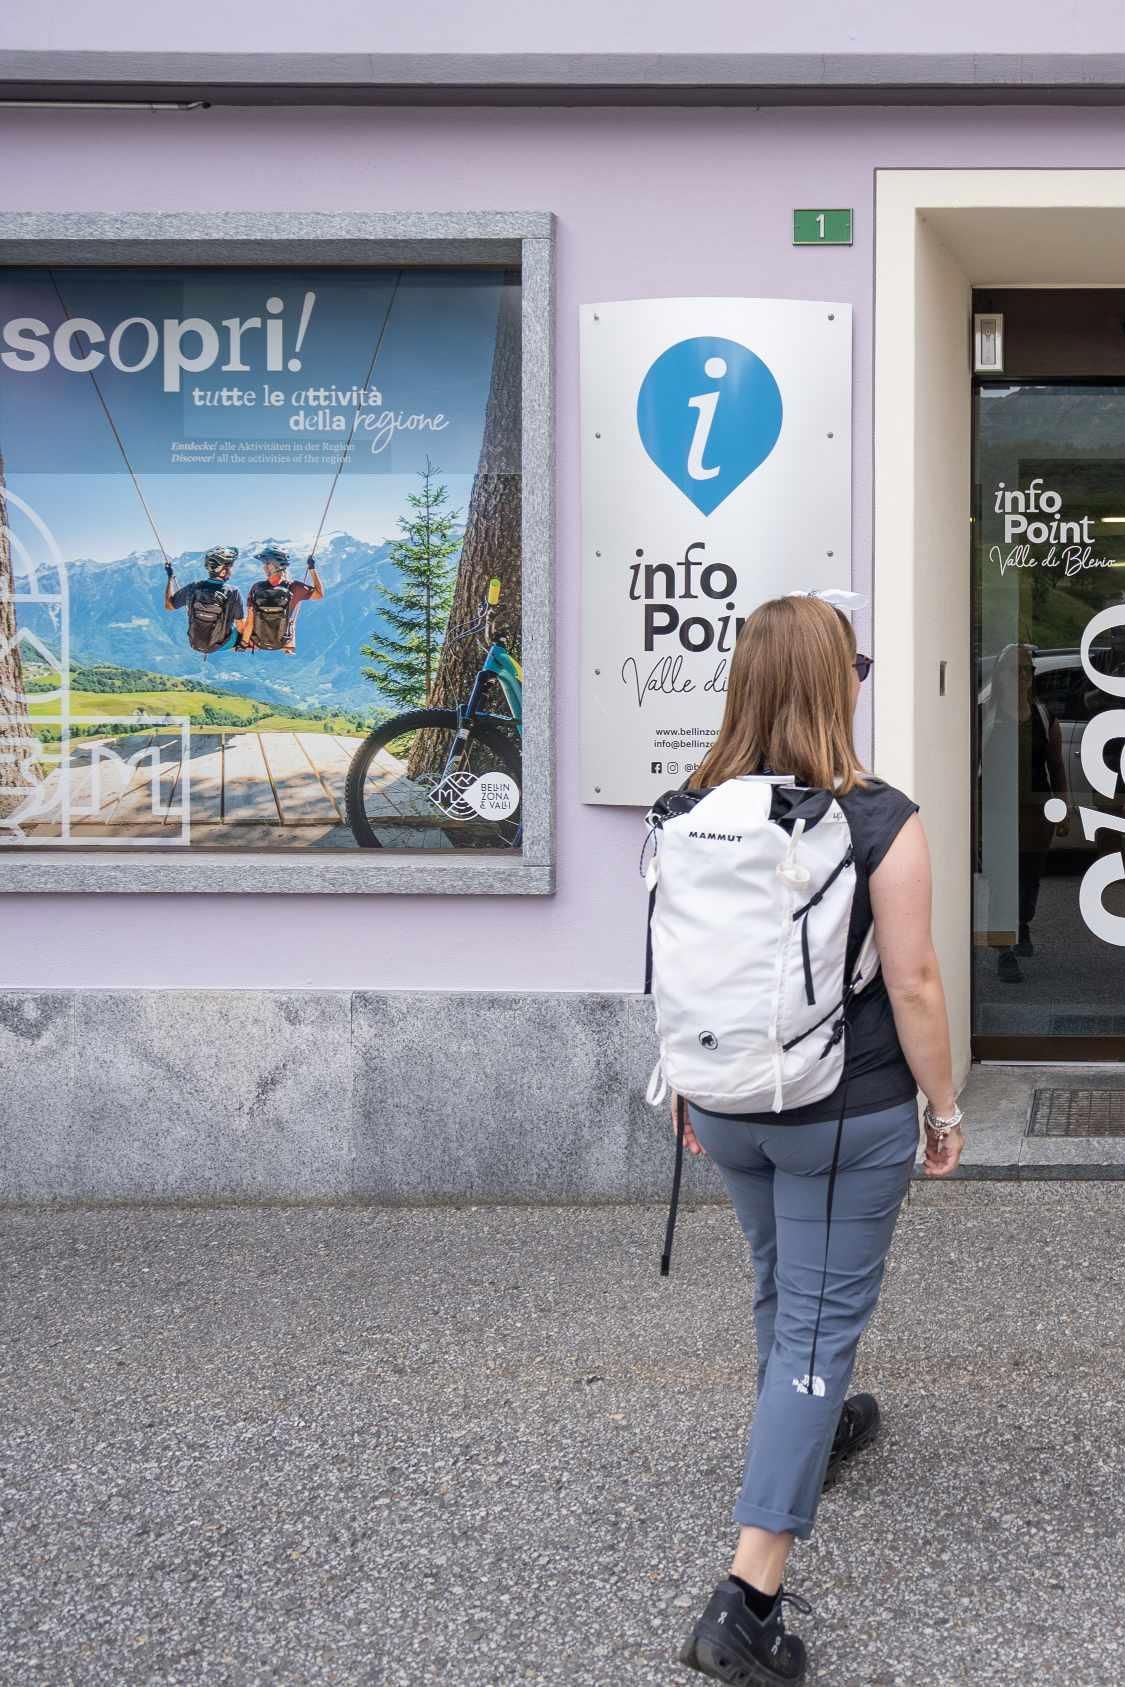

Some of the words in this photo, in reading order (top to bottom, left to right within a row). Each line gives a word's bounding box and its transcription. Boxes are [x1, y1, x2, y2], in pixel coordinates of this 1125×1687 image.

[815, 213, 825, 239] 1
[1, 291, 316, 392] scopri!
[192, 387, 256, 406] tutte
[263, 385, 284, 406] le
[292, 385, 382, 406] attività
[218, 441, 236, 451] alle
[289, 409, 346, 431] della
[353, 409, 449, 454] regione
[230, 453, 245, 463] the
[995, 478, 1062, 513] info
[1005, 513, 1095, 544] Point
[629, 542, 738, 600] info
[989, 545, 1038, 576] Valle
[1041, 547, 1060, 567] di
[1062, 545, 1117, 576] Blenio
[644, 602, 746, 652] Poi
[622, 655, 696, 708] Valle
[481, 793, 510, 801] ZONA
[688, 831, 743, 843] MAMMUT
